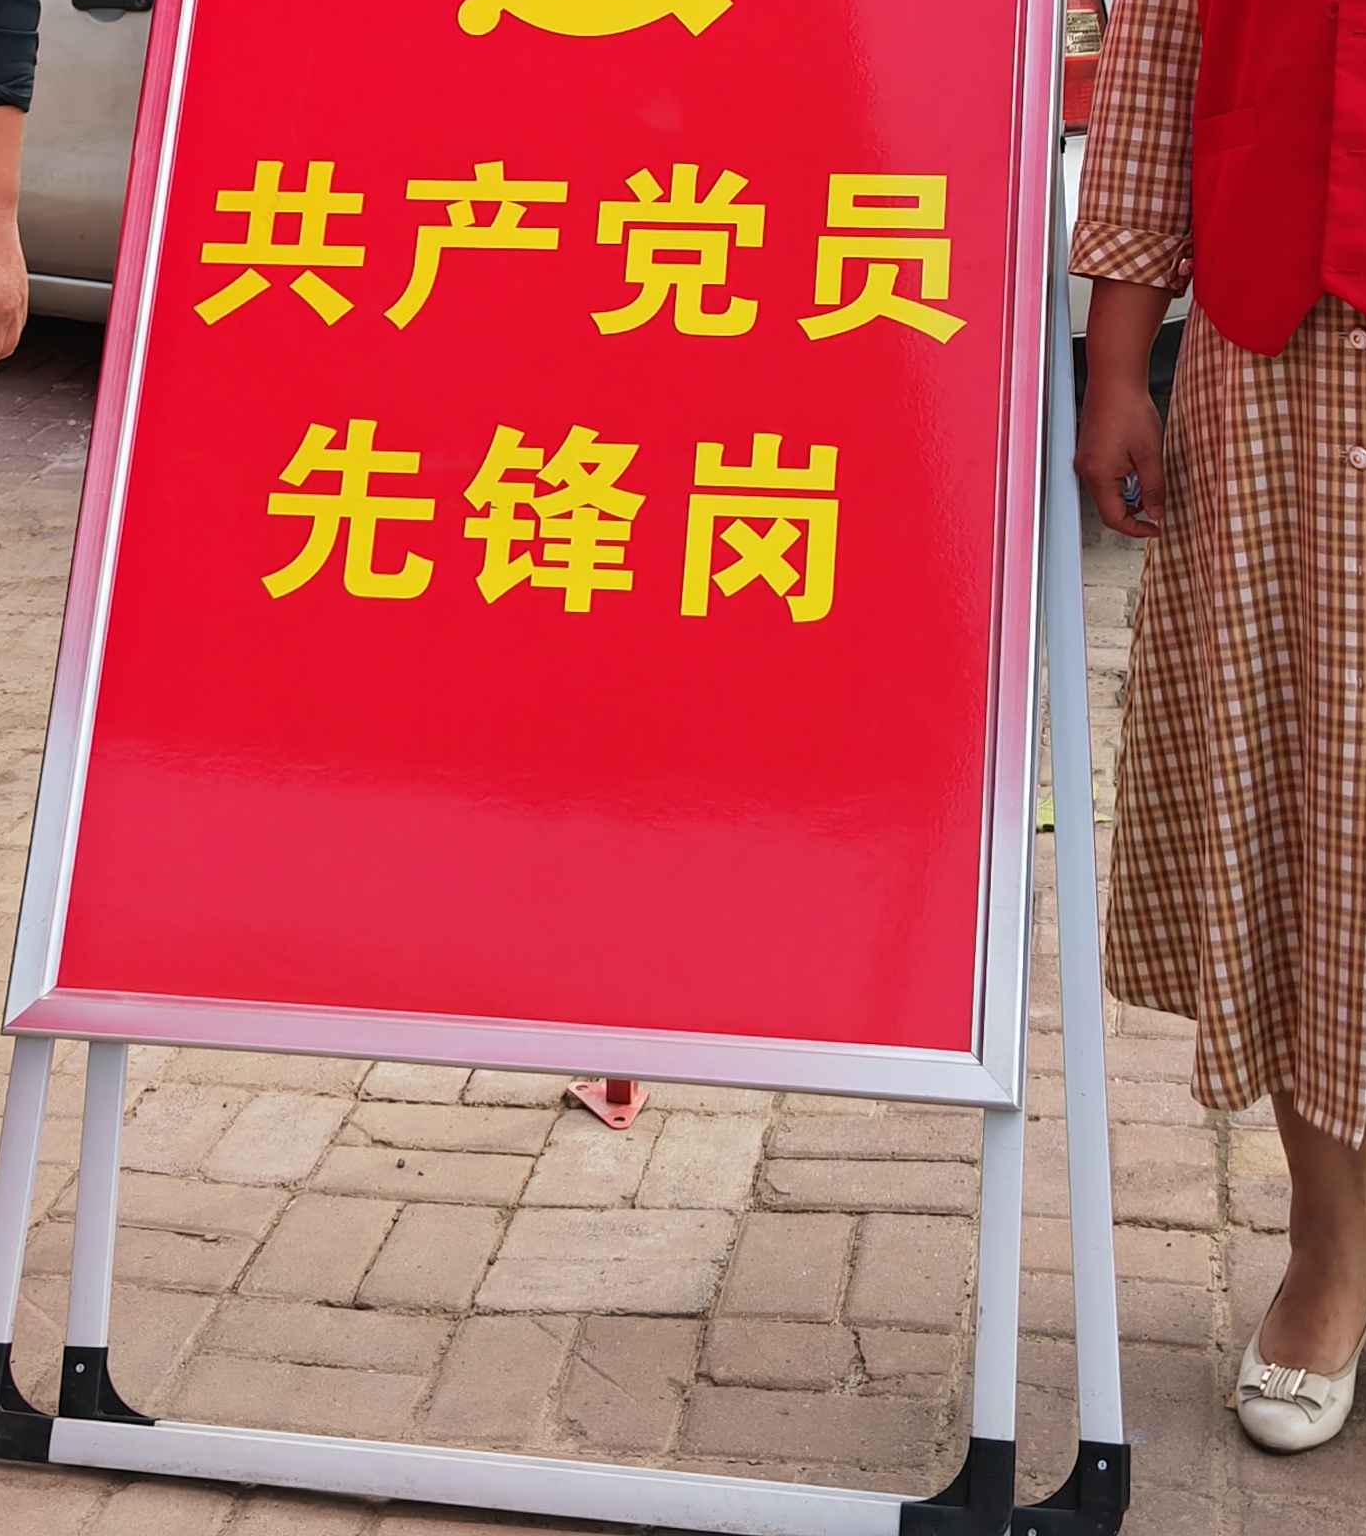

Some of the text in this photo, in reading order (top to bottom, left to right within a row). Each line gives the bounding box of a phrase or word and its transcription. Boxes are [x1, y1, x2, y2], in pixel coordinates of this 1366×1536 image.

[193, 160, 968, 345] 共产党员
[261, 419, 839, 623] 先锋岗
